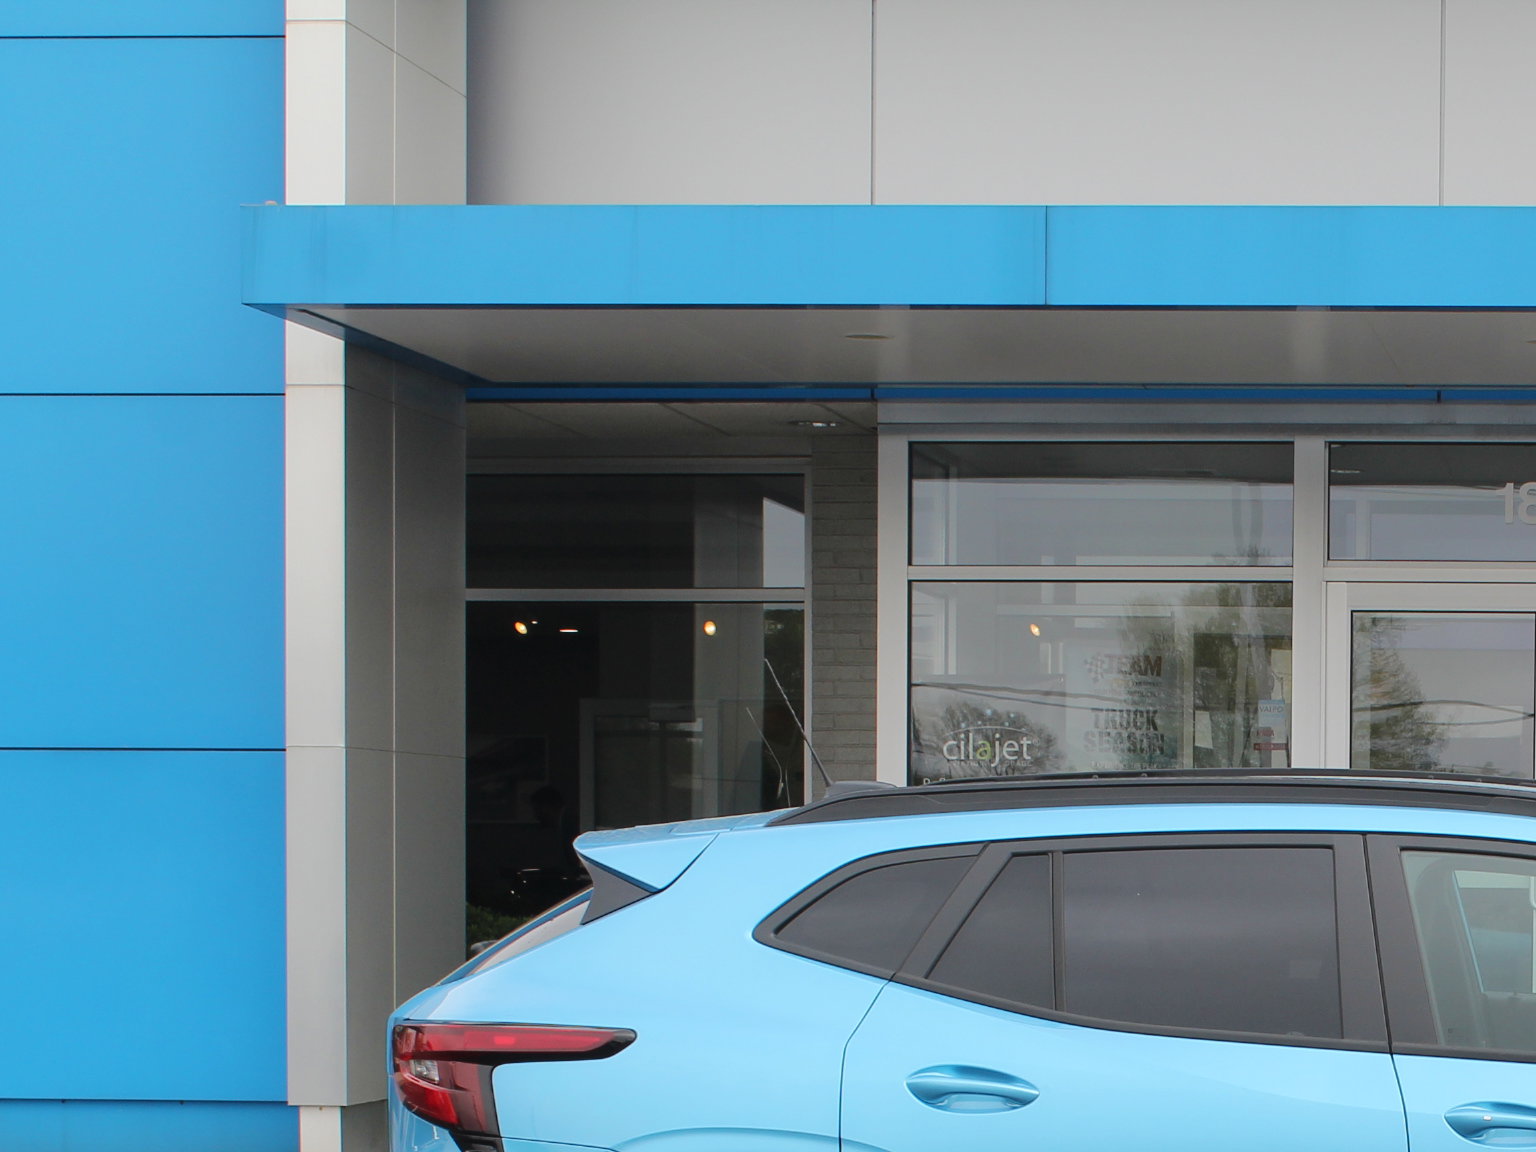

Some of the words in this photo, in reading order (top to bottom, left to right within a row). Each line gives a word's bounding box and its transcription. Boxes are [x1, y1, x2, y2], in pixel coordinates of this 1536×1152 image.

[1104, 653, 1162, 676] TEAM
[1091, 708, 1158, 731] TRUCK
[942, 732, 1032, 767] cilajet
[1083, 731, 1165, 755] SEASON
